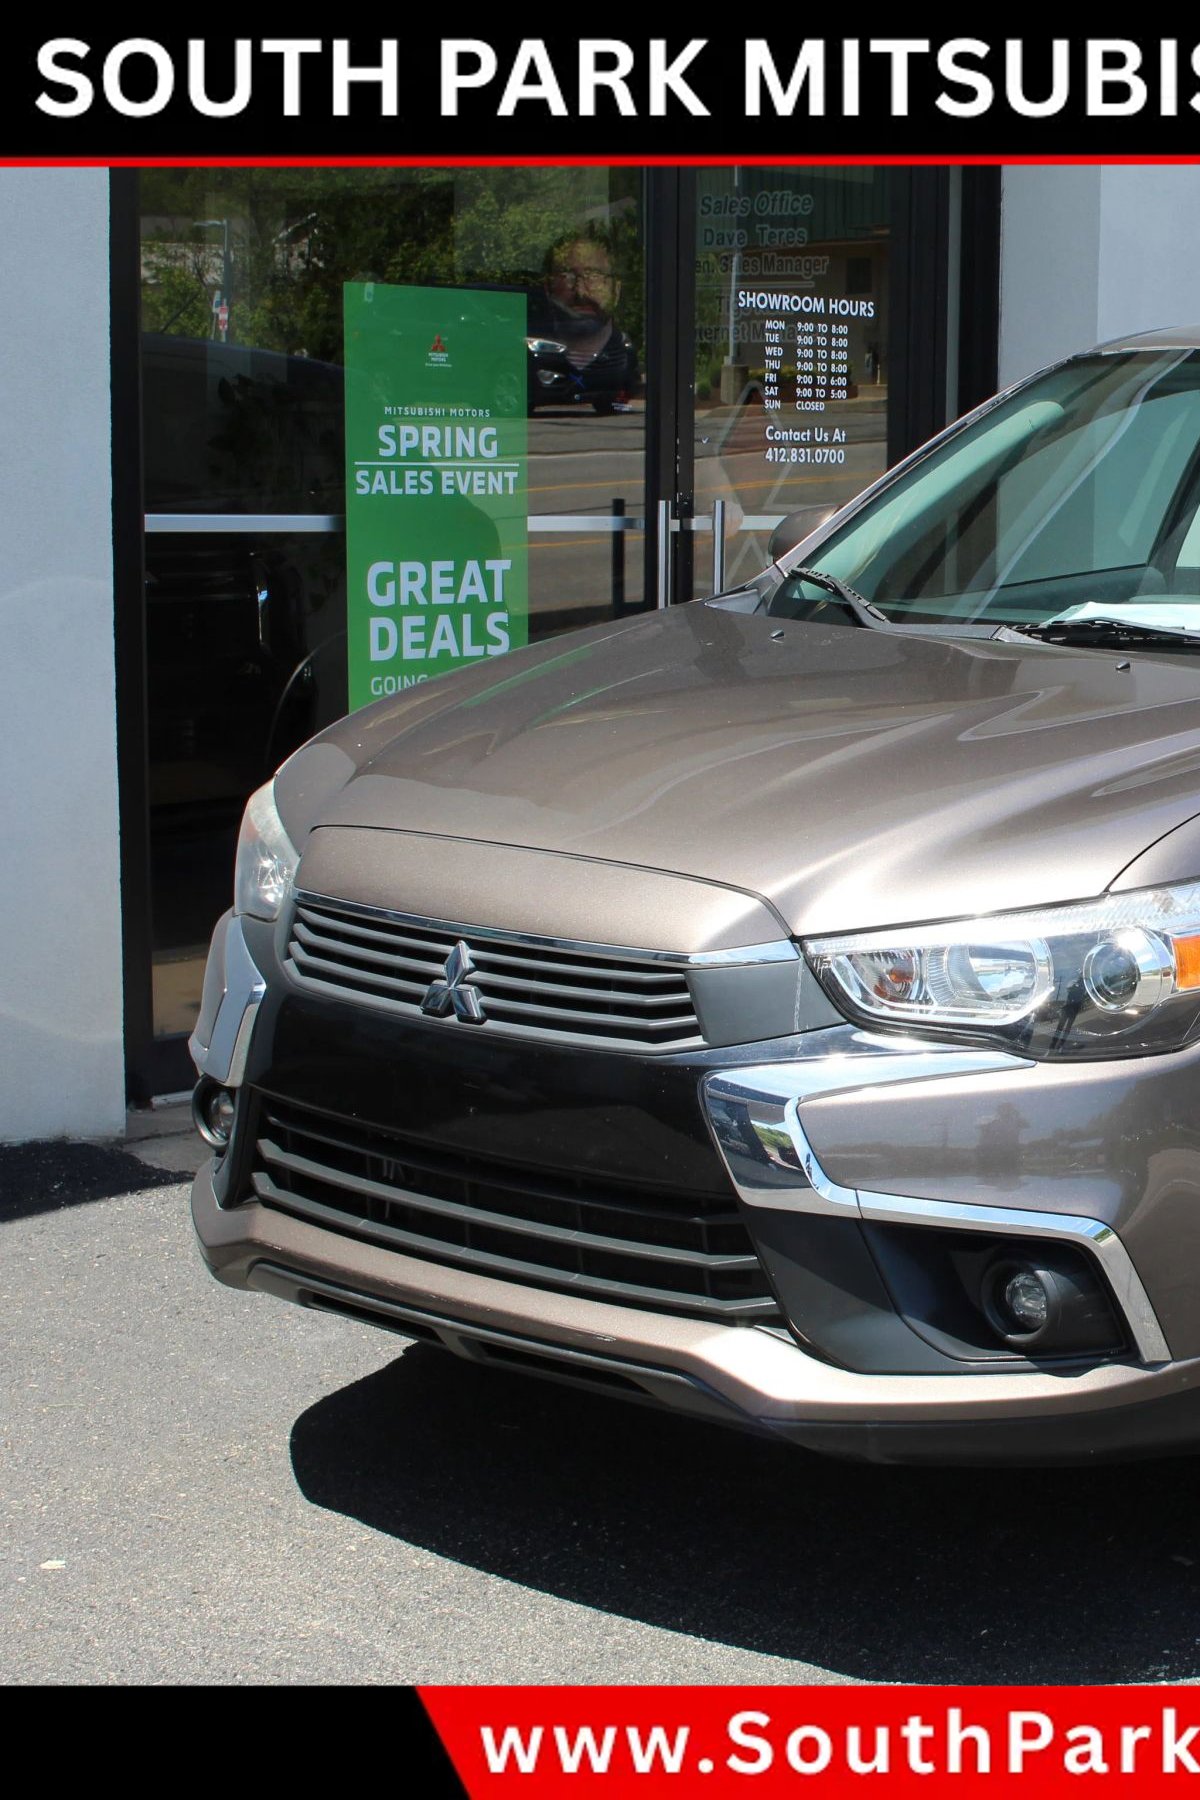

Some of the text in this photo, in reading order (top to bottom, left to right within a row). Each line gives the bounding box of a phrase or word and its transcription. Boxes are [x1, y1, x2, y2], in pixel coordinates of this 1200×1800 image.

[700, 191, 813, 217] Sales Office
[703, 225, 808, 247] Dave Teres
[762, 252, 829, 279] Manager
[738, 290, 825, 314] SHOWROOM
[828, 298, 875, 318] HOURS
[765, 320, 785, 330] MON
[797, 322, 814, 333] 9:00
[817, 323, 828, 333] TO
[831, 324, 848, 335] 8:00
[765, 333, 848, 348] TUE 9:00 TO 8:00
[765, 346, 848, 361] WED 9:00 TO 8:00
[765, 359, 848, 374] THU 9:00 TO 8:00
[764, 373, 847, 387] FRI 9:00 TO 6:00
[764, 386, 847, 400] SAT 9:00 TO 5:00
[384, 406, 491, 418] MITSUBISHI MOTORS
[764, 399, 825, 412] SUN CLOSED
[378, 424, 499, 459] SPRING
[765, 425, 846, 442] Contact Us At
[765, 447, 845, 464] 412.831.0700
[355, 470, 519, 496] SALES EVENT
[367, 559, 512, 607] GREAT
[369, 611, 511, 662] DEALS
